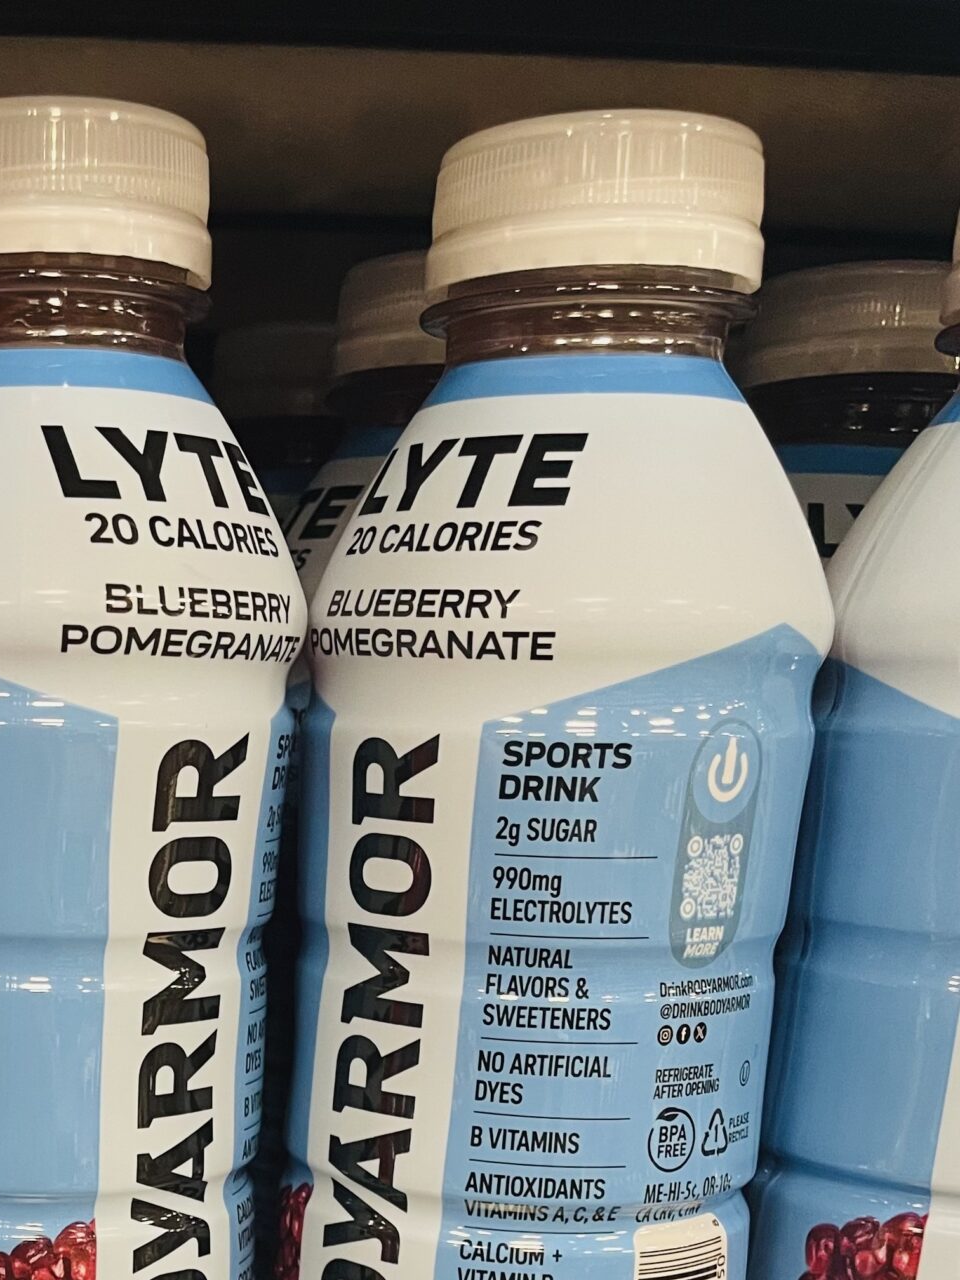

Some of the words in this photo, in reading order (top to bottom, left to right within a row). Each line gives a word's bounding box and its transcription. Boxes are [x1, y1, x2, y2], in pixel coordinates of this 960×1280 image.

[40, 425, 270, 517] LYTE
[358, 433, 589, 516] LYTE
[84, 513, 139, 545] 20
[148, 516, 280, 558] CALORIES
[345, 525, 377, 556] 20
[379, 520, 543, 553] CALORIES
[105, 583, 290, 624] BLUEBERRY
[327, 589, 520, 619] BLUEBERRY
[60, 624, 300, 663] POMEGRANATE
[310, 628, 556, 661] POMEGRANATE
[501, 740, 633, 769] SPORTS
[498, 774, 601, 802] DRINK
[495, 816, 521, 846] 2g
[527, 817, 597, 843] SUGAR
[492, 866, 562, 897] 990mg
[490, 898, 633, 924] ELECTROLYTES
[685, 926, 724, 944] LEARN
[487, 945, 573, 969] NATURAL
[683, 941, 720, 958] MORE
[485, 973, 570, 999] FLAVORS
[575, 978, 590, 999] &
[482, 1003, 612, 1031] SWEETENERS
[477, 1050, 505, 1074] NO
[509, 1052, 611, 1078] ARTIFICIAL
[655, 1063, 714, 1083] REFRIGERATE
[474, 1079, 524, 1105] DYES
[652, 1083, 683, 1100] AFTER
[685, 1078, 720, 1097] OPENING
[470, 1125, 483, 1147] B
[489, 1127, 580, 1154] VITAMINS
[658, 1123, 687, 1143] BPA
[657, 1142, 687, 1158] FREE
[465, 1171, 606, 1200] ANTIOXIDANTS
[464, 1199, 548, 1223] VITAMINS
[607, 1206, 621, 1222] E
[459, 1239, 544, 1266] CALCIUM
